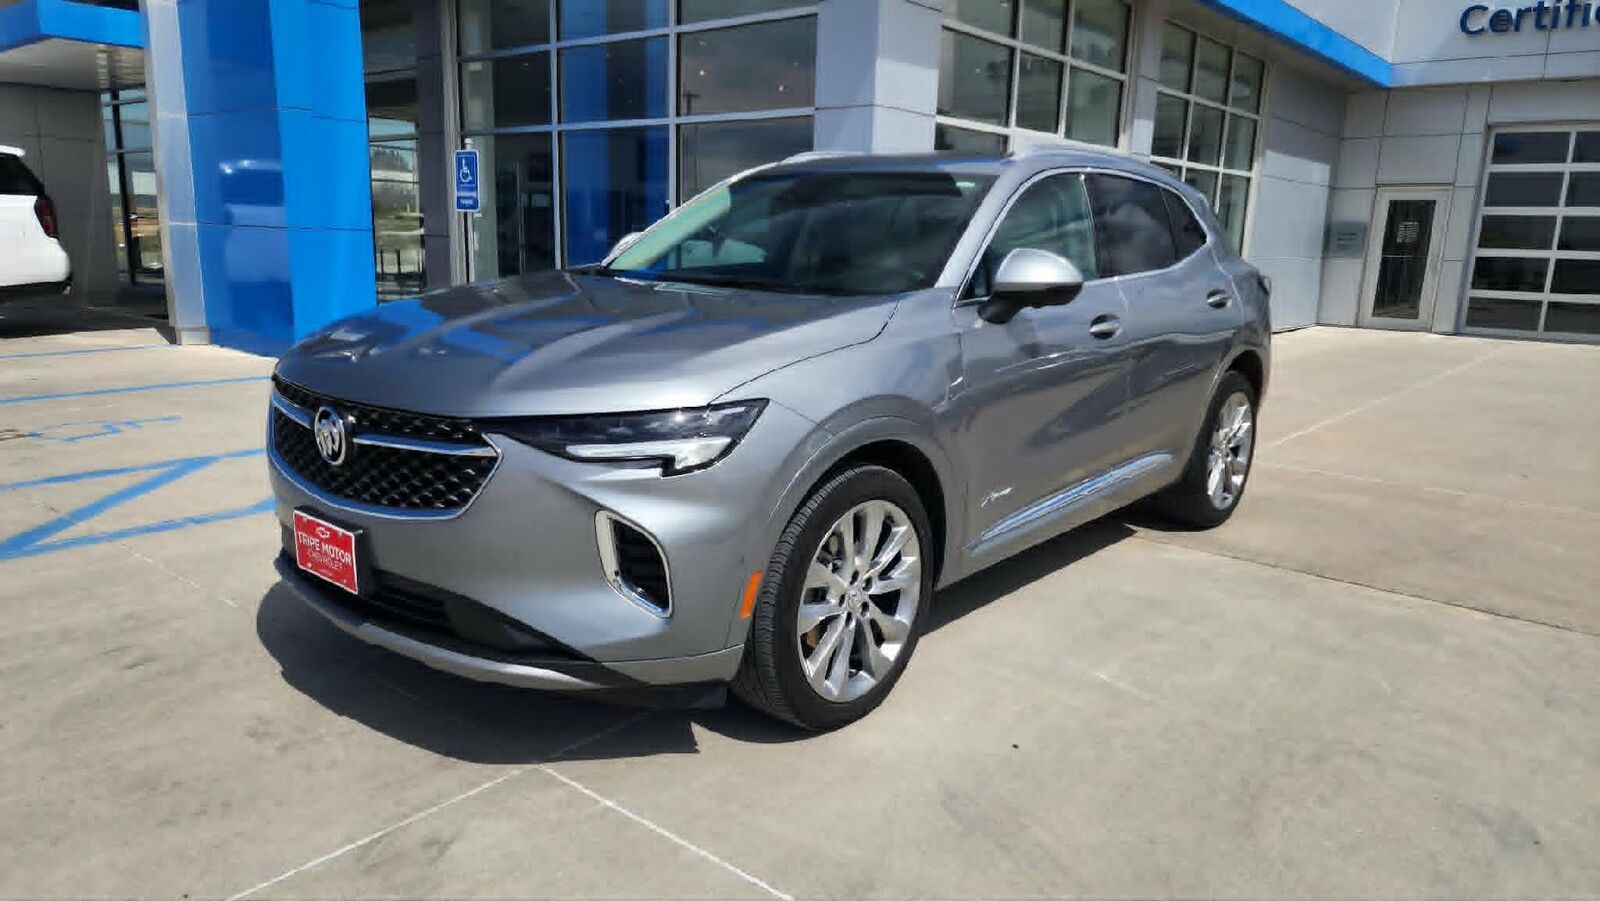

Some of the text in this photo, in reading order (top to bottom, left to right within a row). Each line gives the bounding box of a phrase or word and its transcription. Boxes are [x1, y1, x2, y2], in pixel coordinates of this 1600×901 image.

[1460, 0, 1600, 35] Certifi
[298, 531, 352, 567] TRIPE MOTOR
